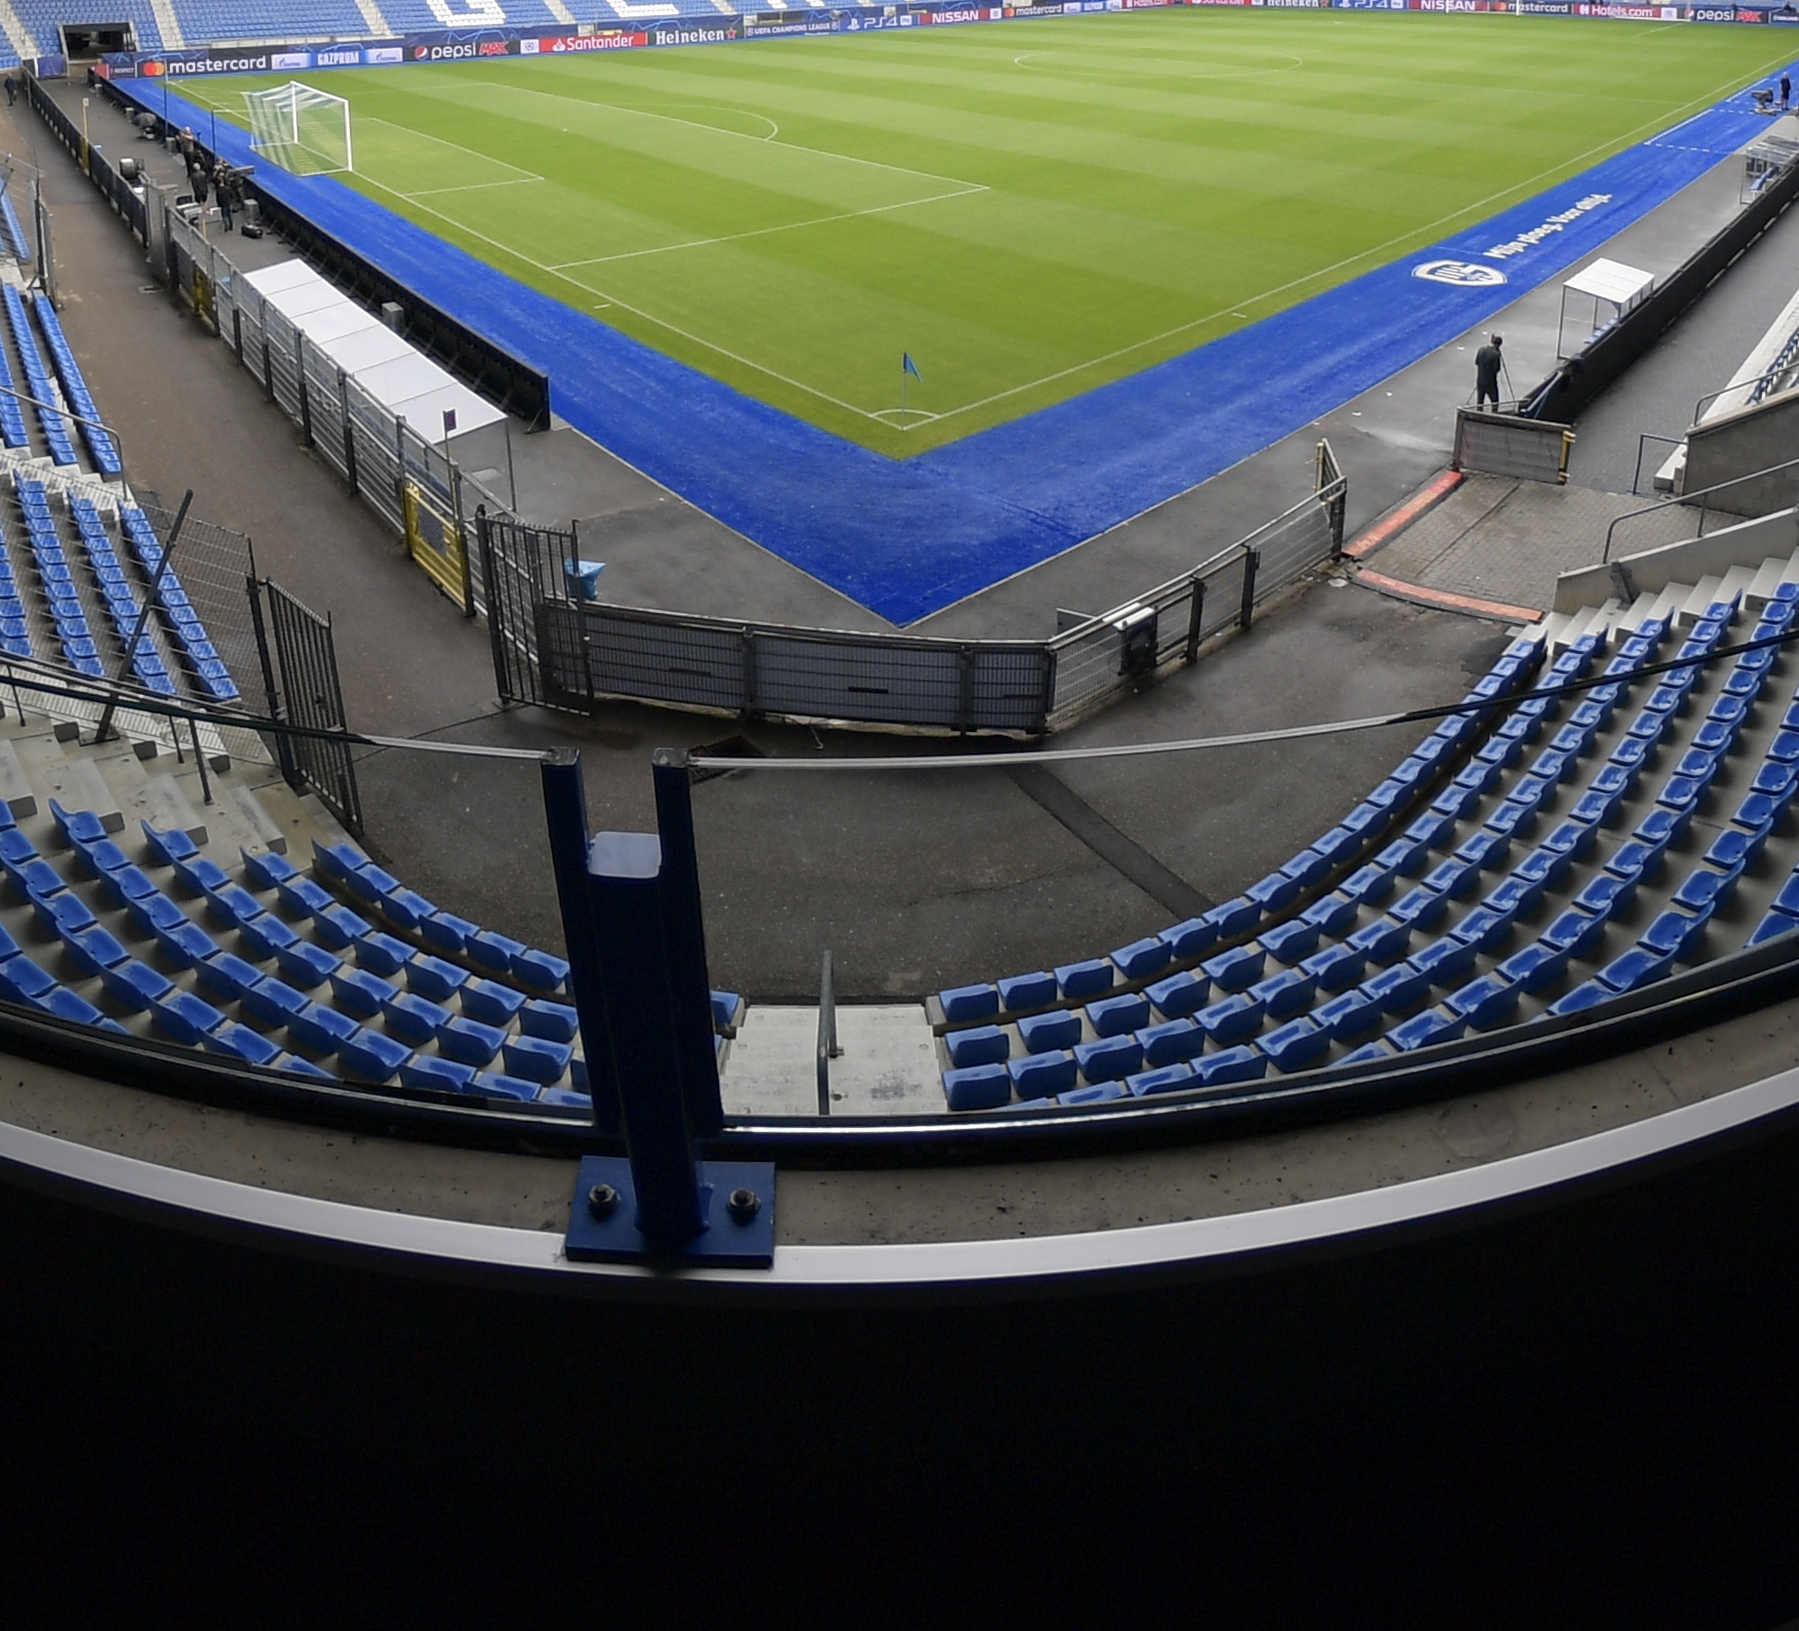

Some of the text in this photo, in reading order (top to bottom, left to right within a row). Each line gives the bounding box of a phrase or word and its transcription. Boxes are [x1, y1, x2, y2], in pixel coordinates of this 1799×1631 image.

[1016, 4, 1062, 17] mastercard
[1421, 0, 1475, 11] NISSAN
[1508, 2, 1568, 13] mastercard
[1592, 6, 1652, 17] Hotels.com
[932, 10, 979, 23] NISSAN
[1697, 9, 1734, 22] pepsi
[754, 22, 830, 35] UEFA CHAMPIONS LEAGUE
[863, 16, 898, 29] PS4
[566, 35, 634, 50] Santander
[655, 29, 724, 45] Heineken
[431, 42, 477, 61] pepsi
[169, 55, 266, 74] mastercard
[317, 51, 359, 66] GAZPROM
